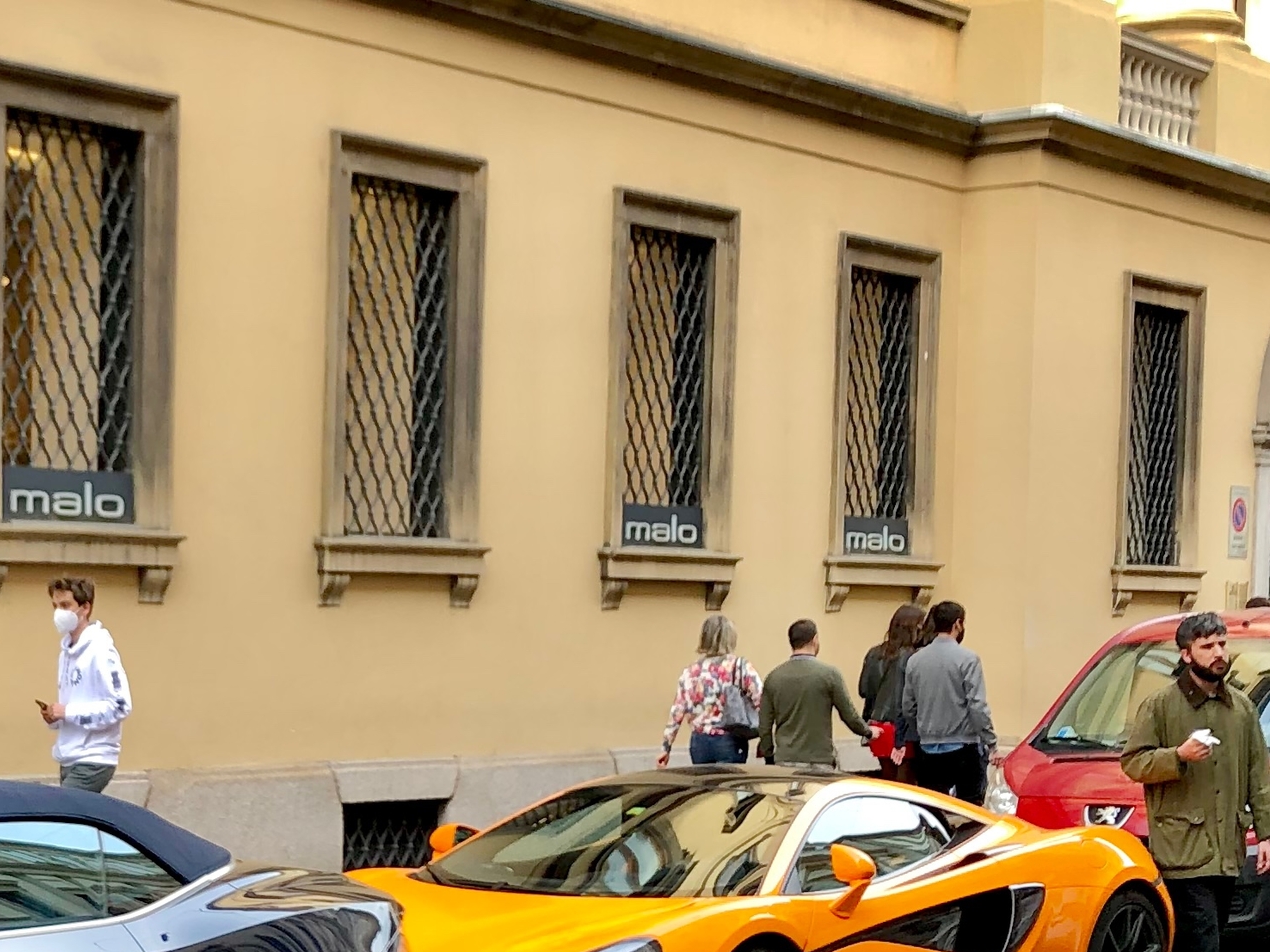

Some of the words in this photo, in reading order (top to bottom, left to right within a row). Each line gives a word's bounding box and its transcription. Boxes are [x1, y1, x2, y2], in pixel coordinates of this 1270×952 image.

[10, 480, 125, 519] malo
[624, 513, 697, 544] malo
[845, 524, 905, 553] malo
